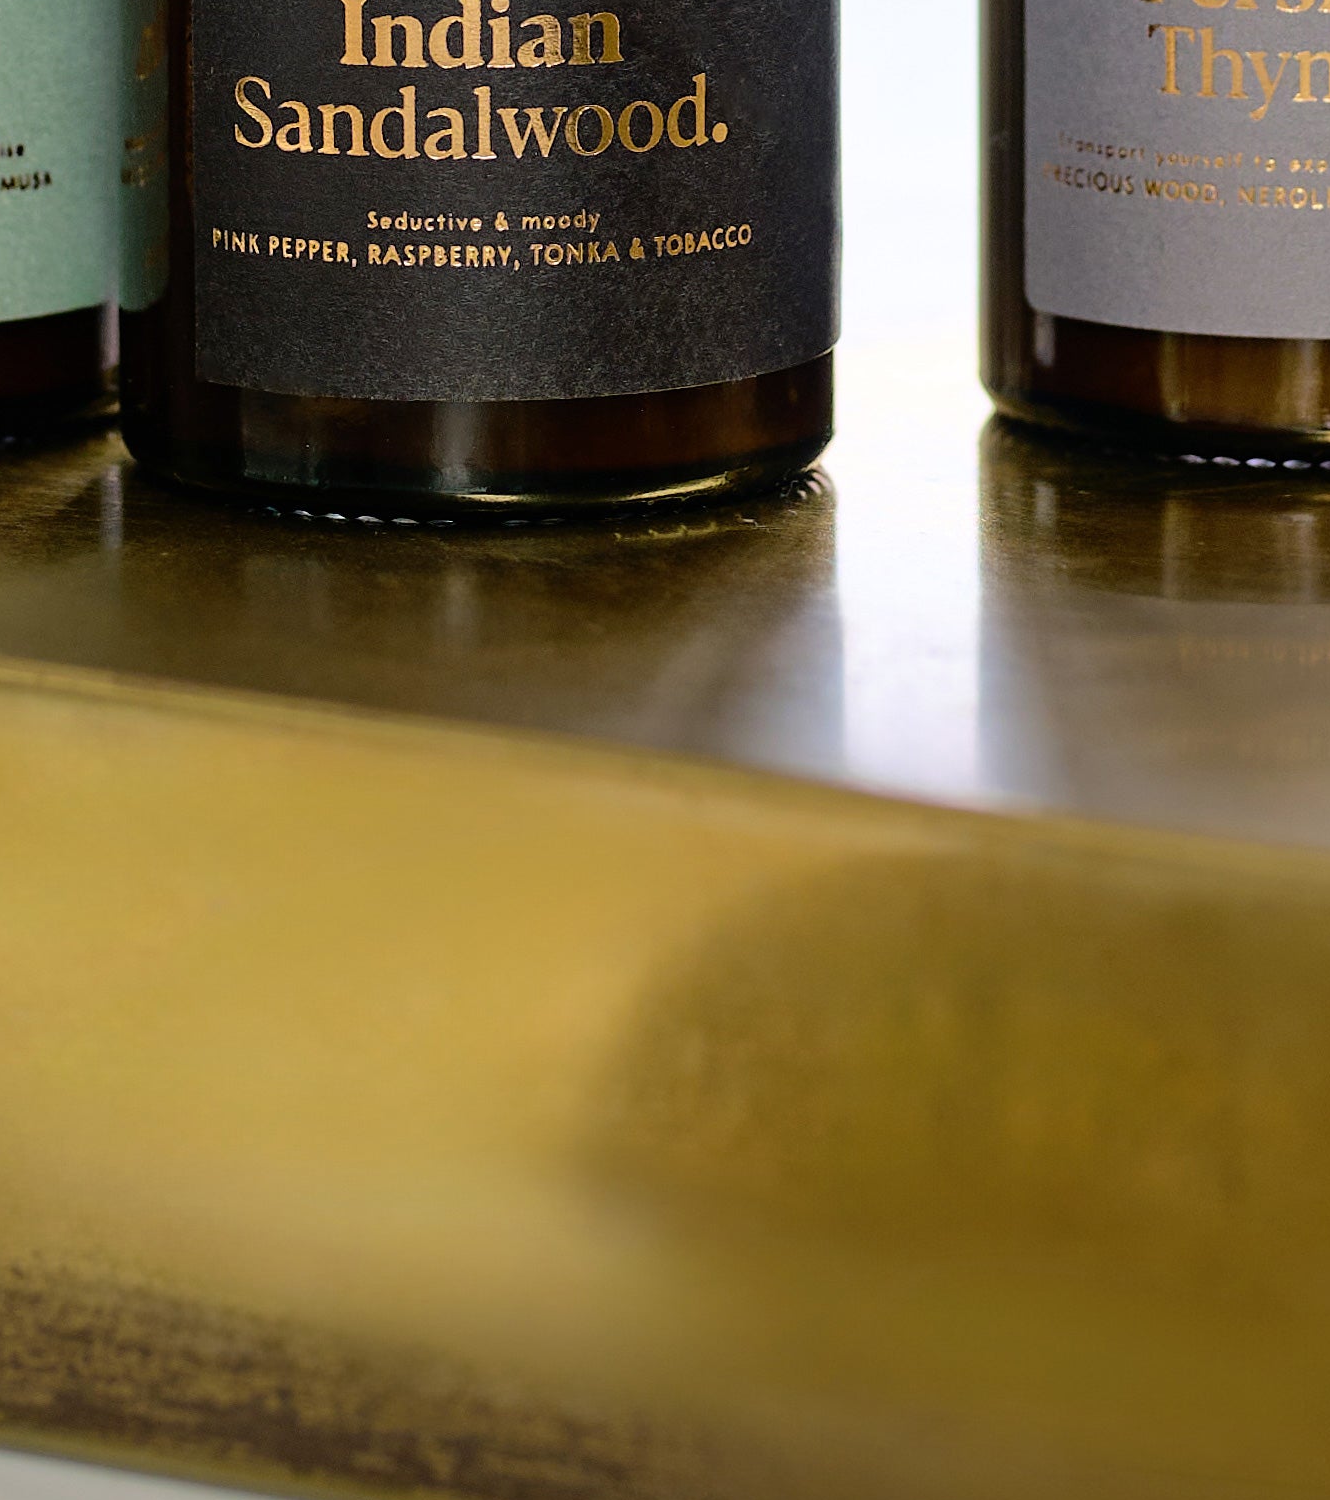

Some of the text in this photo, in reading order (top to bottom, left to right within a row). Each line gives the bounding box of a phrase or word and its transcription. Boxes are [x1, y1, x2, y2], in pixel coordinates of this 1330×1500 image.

[234, 73, 729, 160] Sandalwood.
[1144, 178, 1227, 207] WOOD,
[366, 208, 601, 233] Seductive & moody
[212, 223, 752, 271] PINK PEPPER, RASPBERRY, TONKA & TOBACCO
